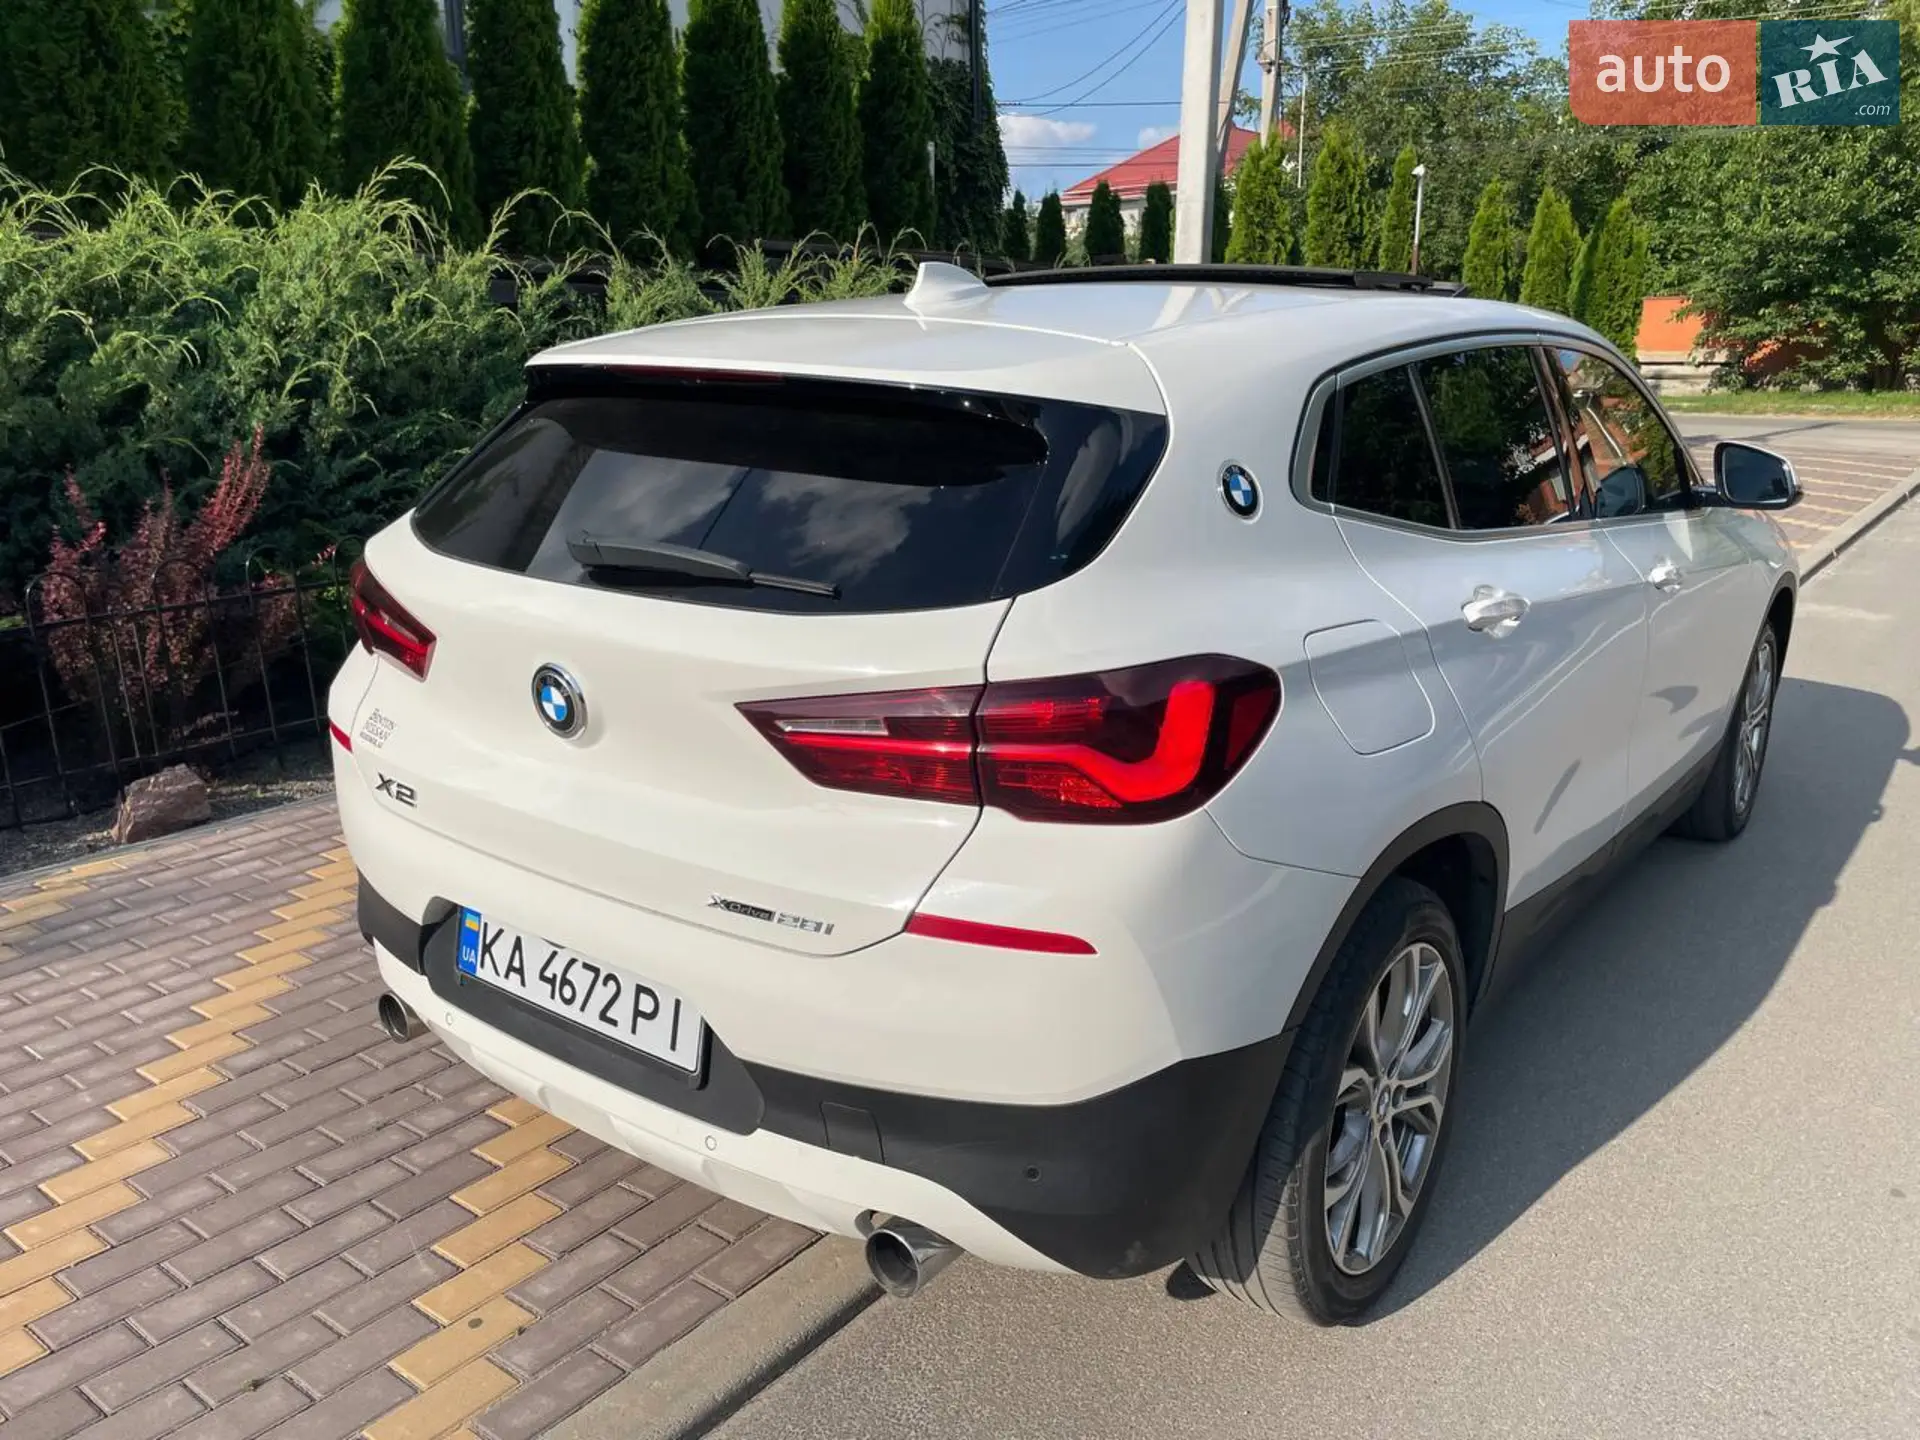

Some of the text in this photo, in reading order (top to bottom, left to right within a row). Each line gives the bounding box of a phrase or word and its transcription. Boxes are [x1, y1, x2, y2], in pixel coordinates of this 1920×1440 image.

[375, 771, 417, 808] X2
[462, 944, 476, 965] UA
[480, 921, 682, 1053] KA 4672 PI
